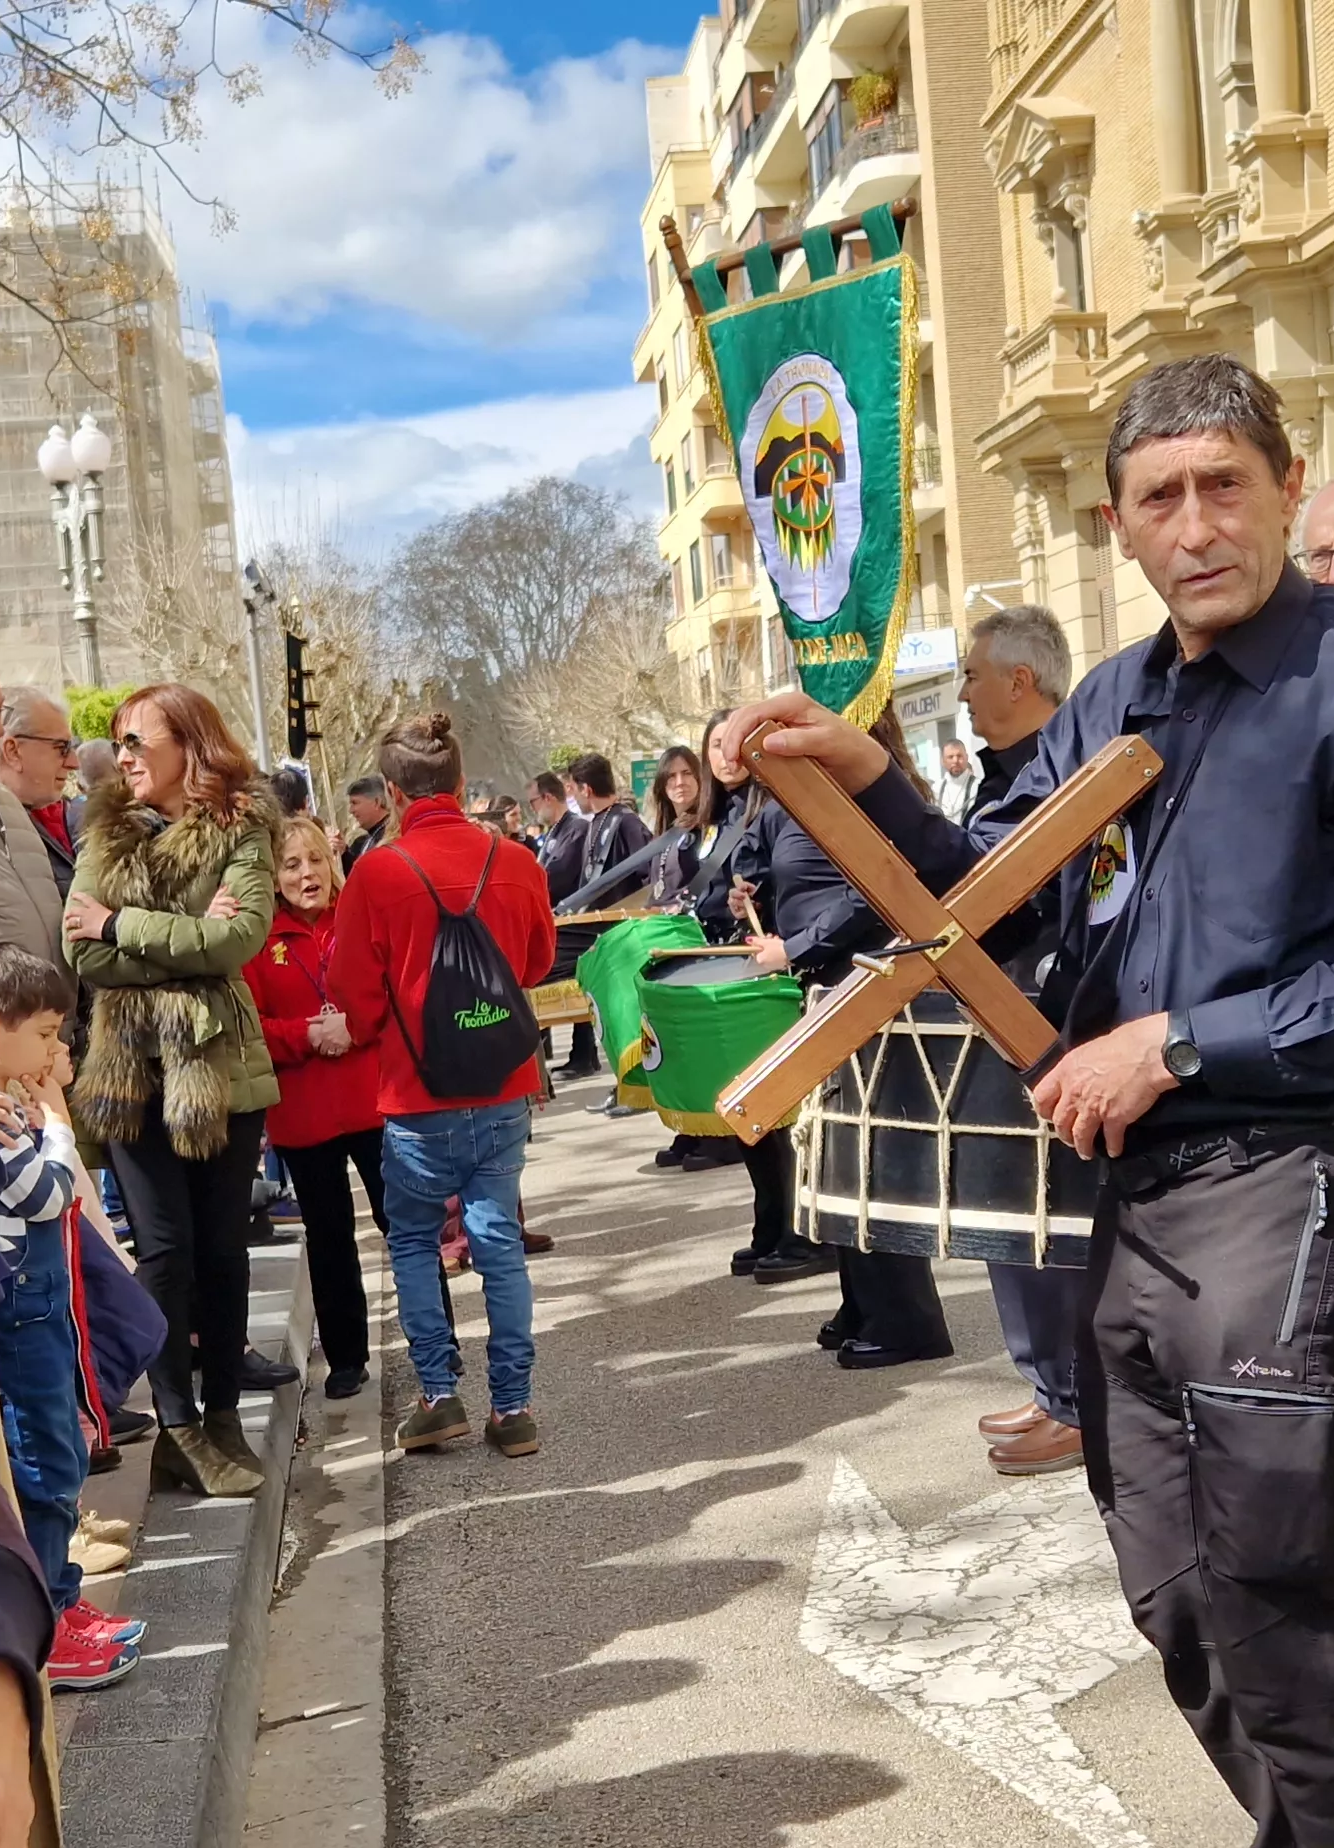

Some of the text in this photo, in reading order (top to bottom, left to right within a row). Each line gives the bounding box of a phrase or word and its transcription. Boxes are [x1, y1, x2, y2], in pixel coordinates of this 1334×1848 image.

[900, 692, 942, 720] VITALDENT
[454, 1004, 511, 1031] Tronada
[474, 996, 492, 1017] La
